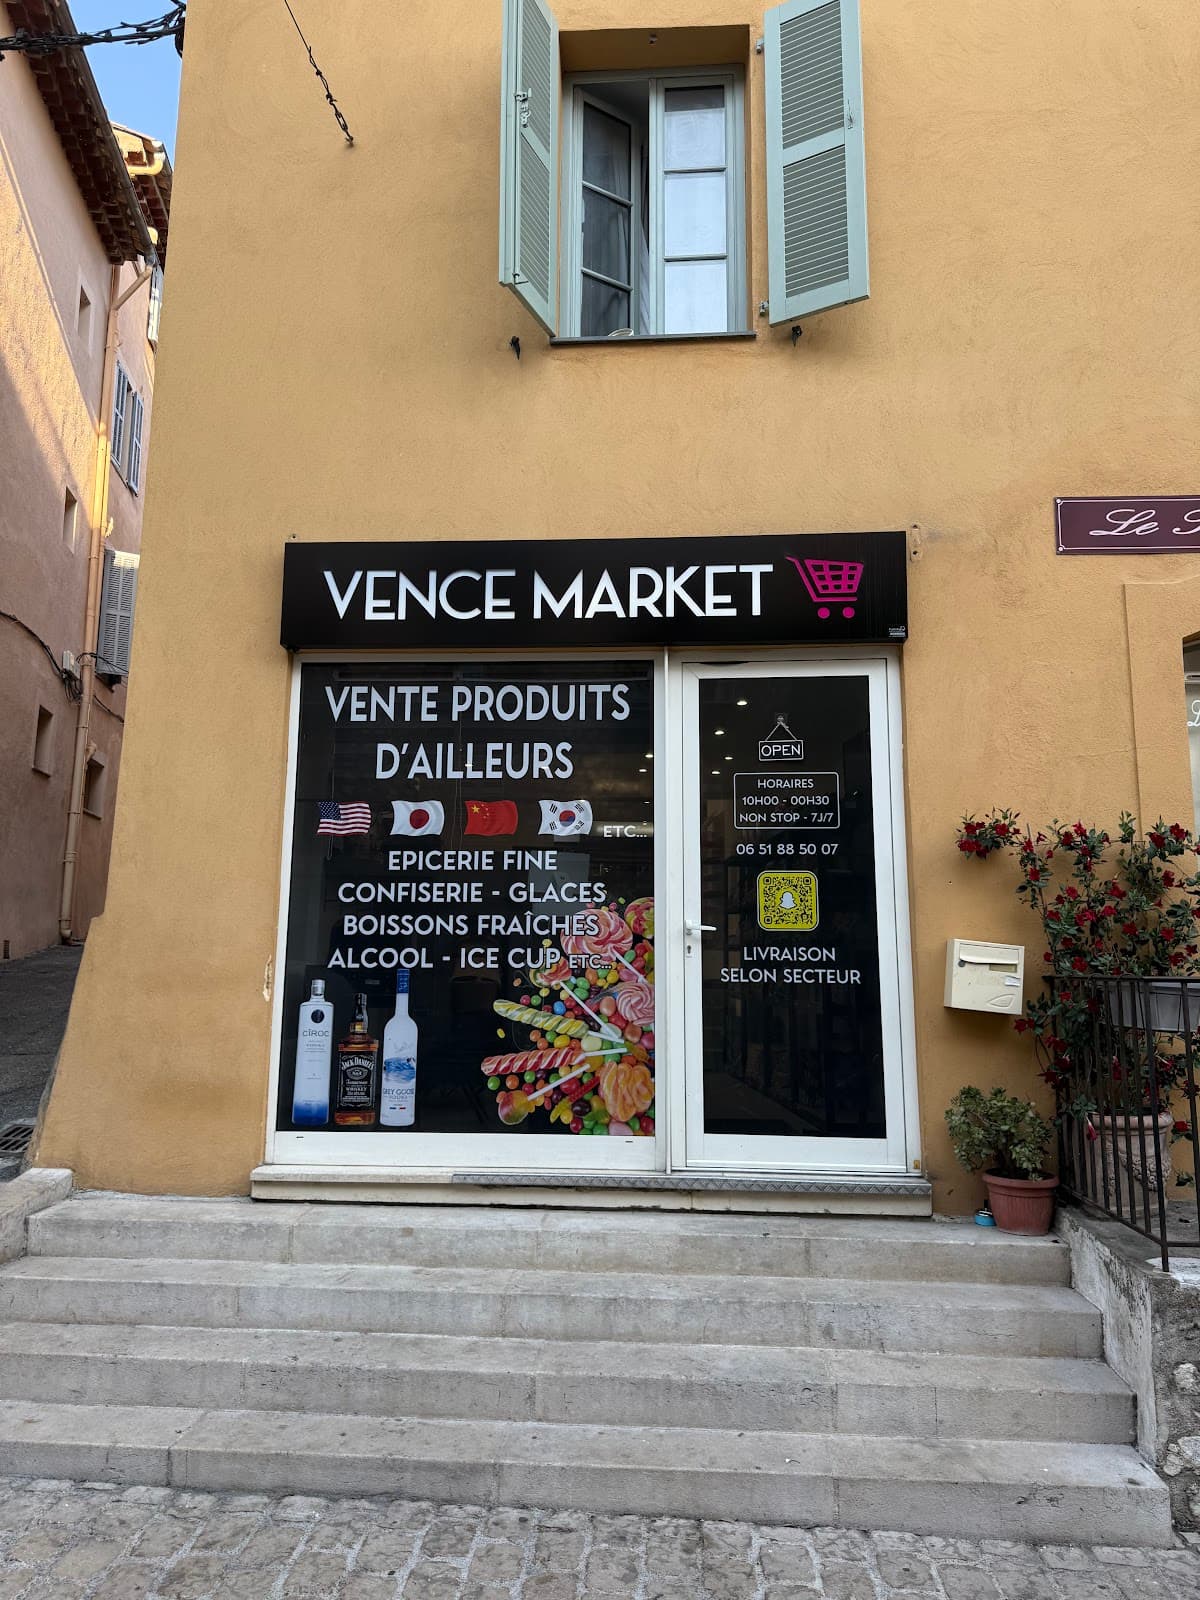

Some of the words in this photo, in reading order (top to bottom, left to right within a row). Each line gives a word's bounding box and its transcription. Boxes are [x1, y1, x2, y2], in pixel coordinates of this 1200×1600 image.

[1089, 509, 1159, 535] Le
[323, 569, 516, 621] VENCE
[533, 565, 773, 619] MARKET
[325, 685, 439, 722] VENTE
[451, 683, 630, 722] PRODUITS
[760, 744, 801, 757] OPEN
[757, 778, 814, 789] HORAIRES
[742, 795, 779, 806] 10H00
[790, 795, 830, 806] 00H30
[739, 812, 767, 823] NON
[770, 812, 800, 823] STOP
[811, 812, 834, 823] 7J/7
[736, 843, 755, 855] 06
[758, 843, 772, 855] 51
[776, 843, 795, 855] 88
[798, 843, 817, 855] 50
[821, 843, 839, 855] 07
[388, 850, 495, 871] EPICERIE
[503, 850, 558, 871] FINE
[338, 882, 483, 903] CONFISERIE
[509, 882, 606, 903] GLACES
[343, 914, 469, 936] BOISSONS
[477, 910, 600, 936] FRAÎCHES
[327, 947, 434, 969] ALCOOL
[460, 947, 499, 969] ICE
[507, 947, 561, 969] CUP
[743, 946, 836, 962] LIVRAISON
[720, 967, 777, 983] SELON
[783, 968, 861, 984] SECTEUR
